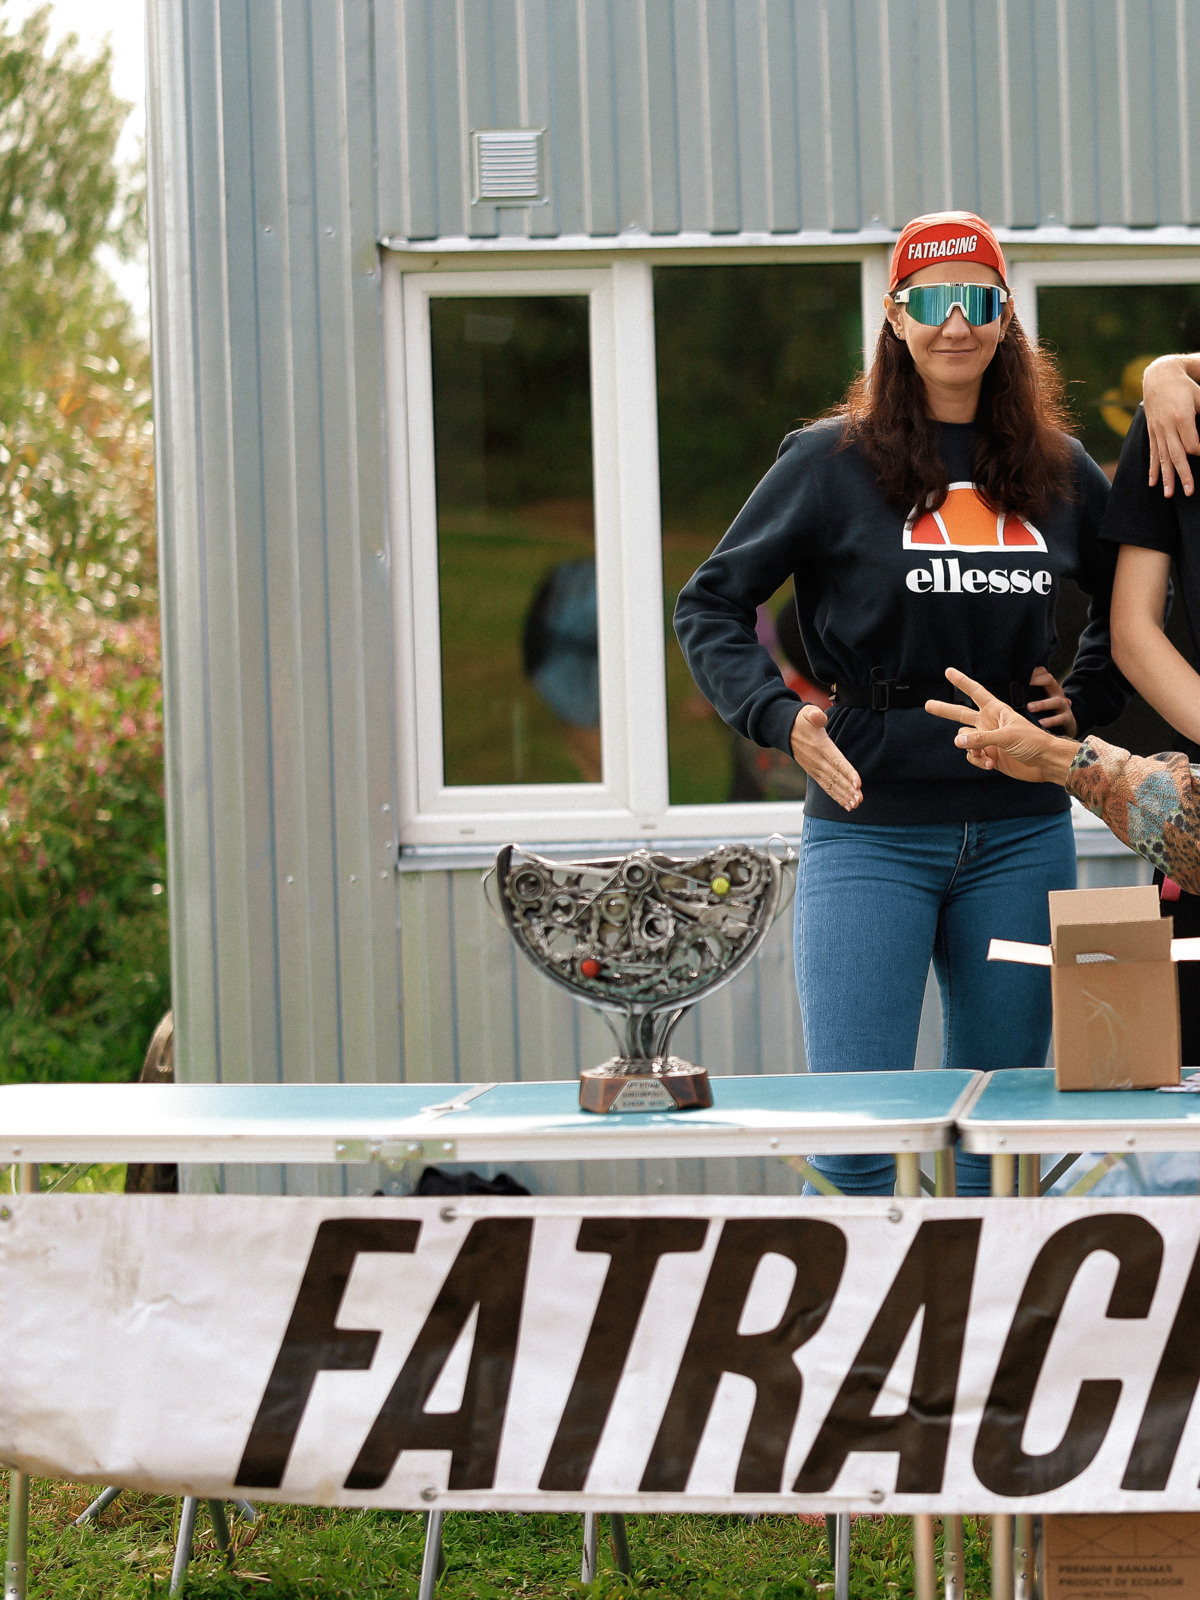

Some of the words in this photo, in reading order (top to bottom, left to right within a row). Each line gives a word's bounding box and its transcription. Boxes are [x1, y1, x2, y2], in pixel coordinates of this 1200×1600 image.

[907, 235, 978, 260] FATRACING
[905, 557, 1053, 596] ellesse
[1058, 1564, 1113, 1573] PREMIUM
[1116, 1564, 1173, 1573] BANANAS
[1058, 1577, 1111, 1586] PRODUCT
[1114, 1577, 1127, 1586] OF
[1131, 1577, 1184, 1586] ECUADOR
